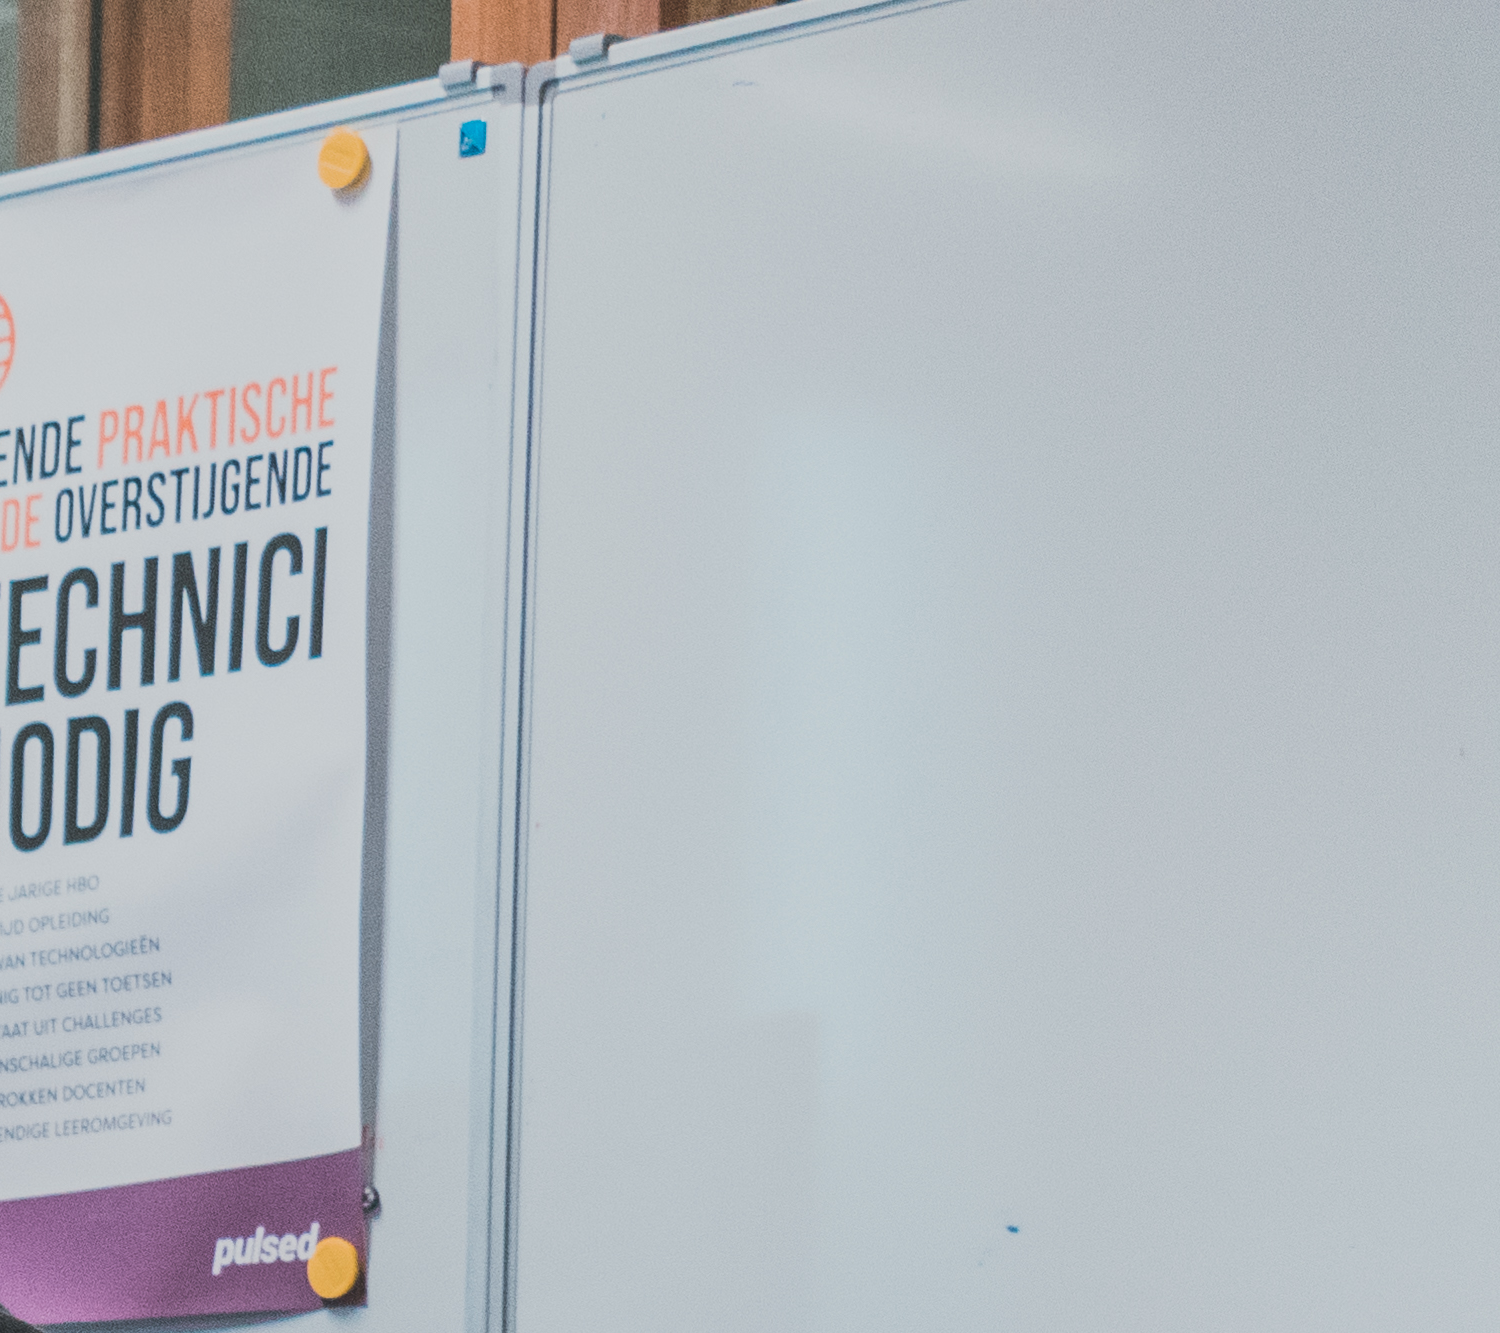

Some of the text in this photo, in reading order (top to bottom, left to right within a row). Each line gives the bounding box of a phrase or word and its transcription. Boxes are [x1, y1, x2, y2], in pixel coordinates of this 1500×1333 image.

[97, 366, 337, 469] PRAKTISCHE
[52, 440, 333, 543] OVERSTIJGENDE
[8, 879, 61, 902] JARIGE
[66, 875, 100, 894] HBO
[29, 908, 110, 933] OPLEIDING
[30, 936, 161, 967] TECHNOLOGIEËN
[23, 984, 51, 1002] TOT
[56, 979, 97, 999] GEEN
[101, 970, 173, 995] TOETSEN
[33, 1018, 57, 1036] UIT
[61, 1006, 162, 1033] CHALLENGES
[87, 1042, 161, 1064] GROEPEN
[62, 1077, 146, 1102] DOCENTEN
[54, 1109, 173, 1137] LEEROMGEVING
[211, 1221, 320, 1277] pulsed
